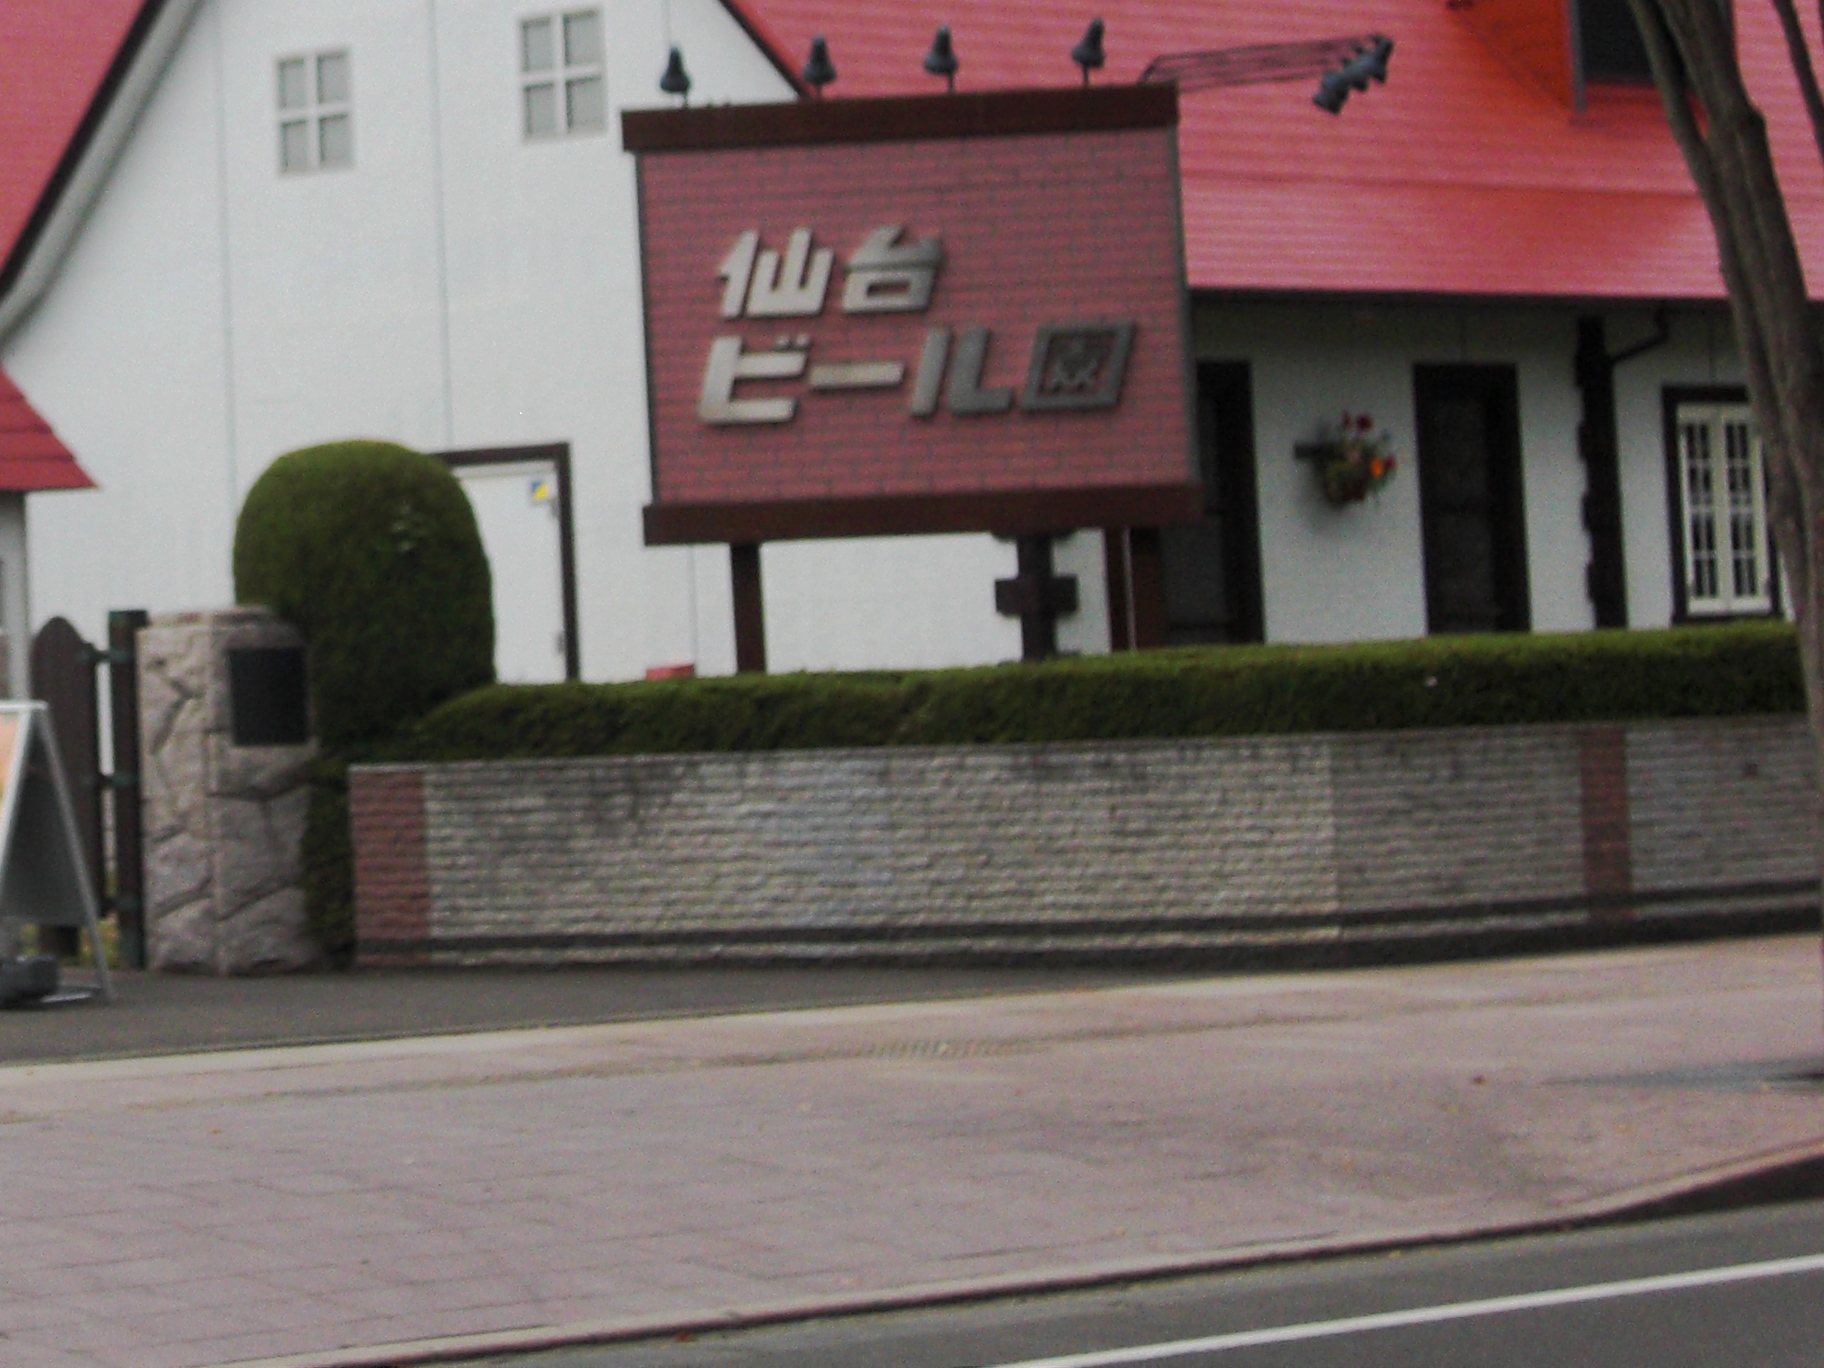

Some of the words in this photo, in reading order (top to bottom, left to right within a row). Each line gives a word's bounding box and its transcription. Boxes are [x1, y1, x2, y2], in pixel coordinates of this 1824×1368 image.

[717, 223, 946, 320] 仙台
[697, 322, 1137, 425] ビール園
